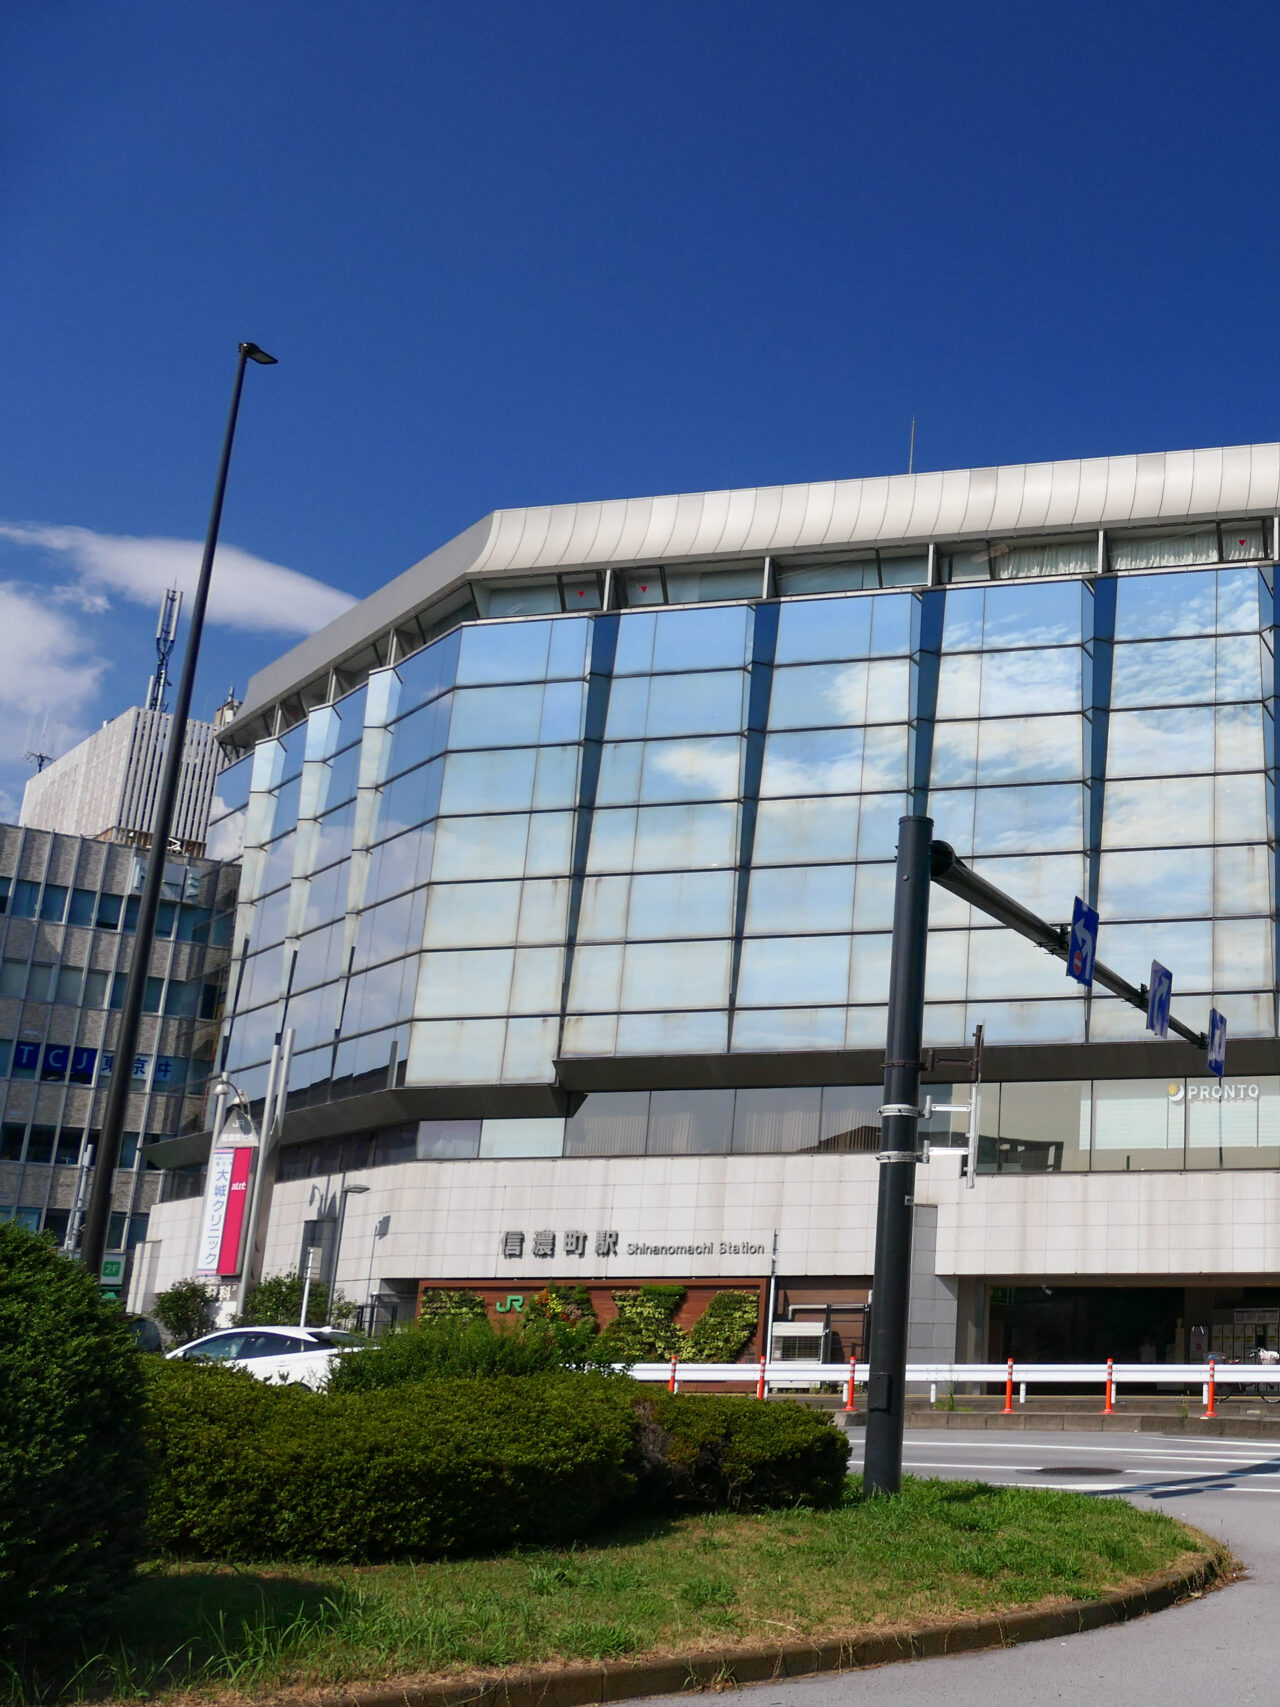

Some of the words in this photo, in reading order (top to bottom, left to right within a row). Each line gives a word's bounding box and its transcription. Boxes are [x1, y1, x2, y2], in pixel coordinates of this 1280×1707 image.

[20, 1045, 88, 1070] TCJ
[1188, 1084, 1259, 1100] PRONTO
[501, 1229, 620, 1259] 信濃町駅
[626, 1241, 714, 1256] Shinanomachi
[719, 1241, 765, 1255] Station
[105, 1264, 120, 1273] 2F
[496, 1295, 524, 1313] JR
